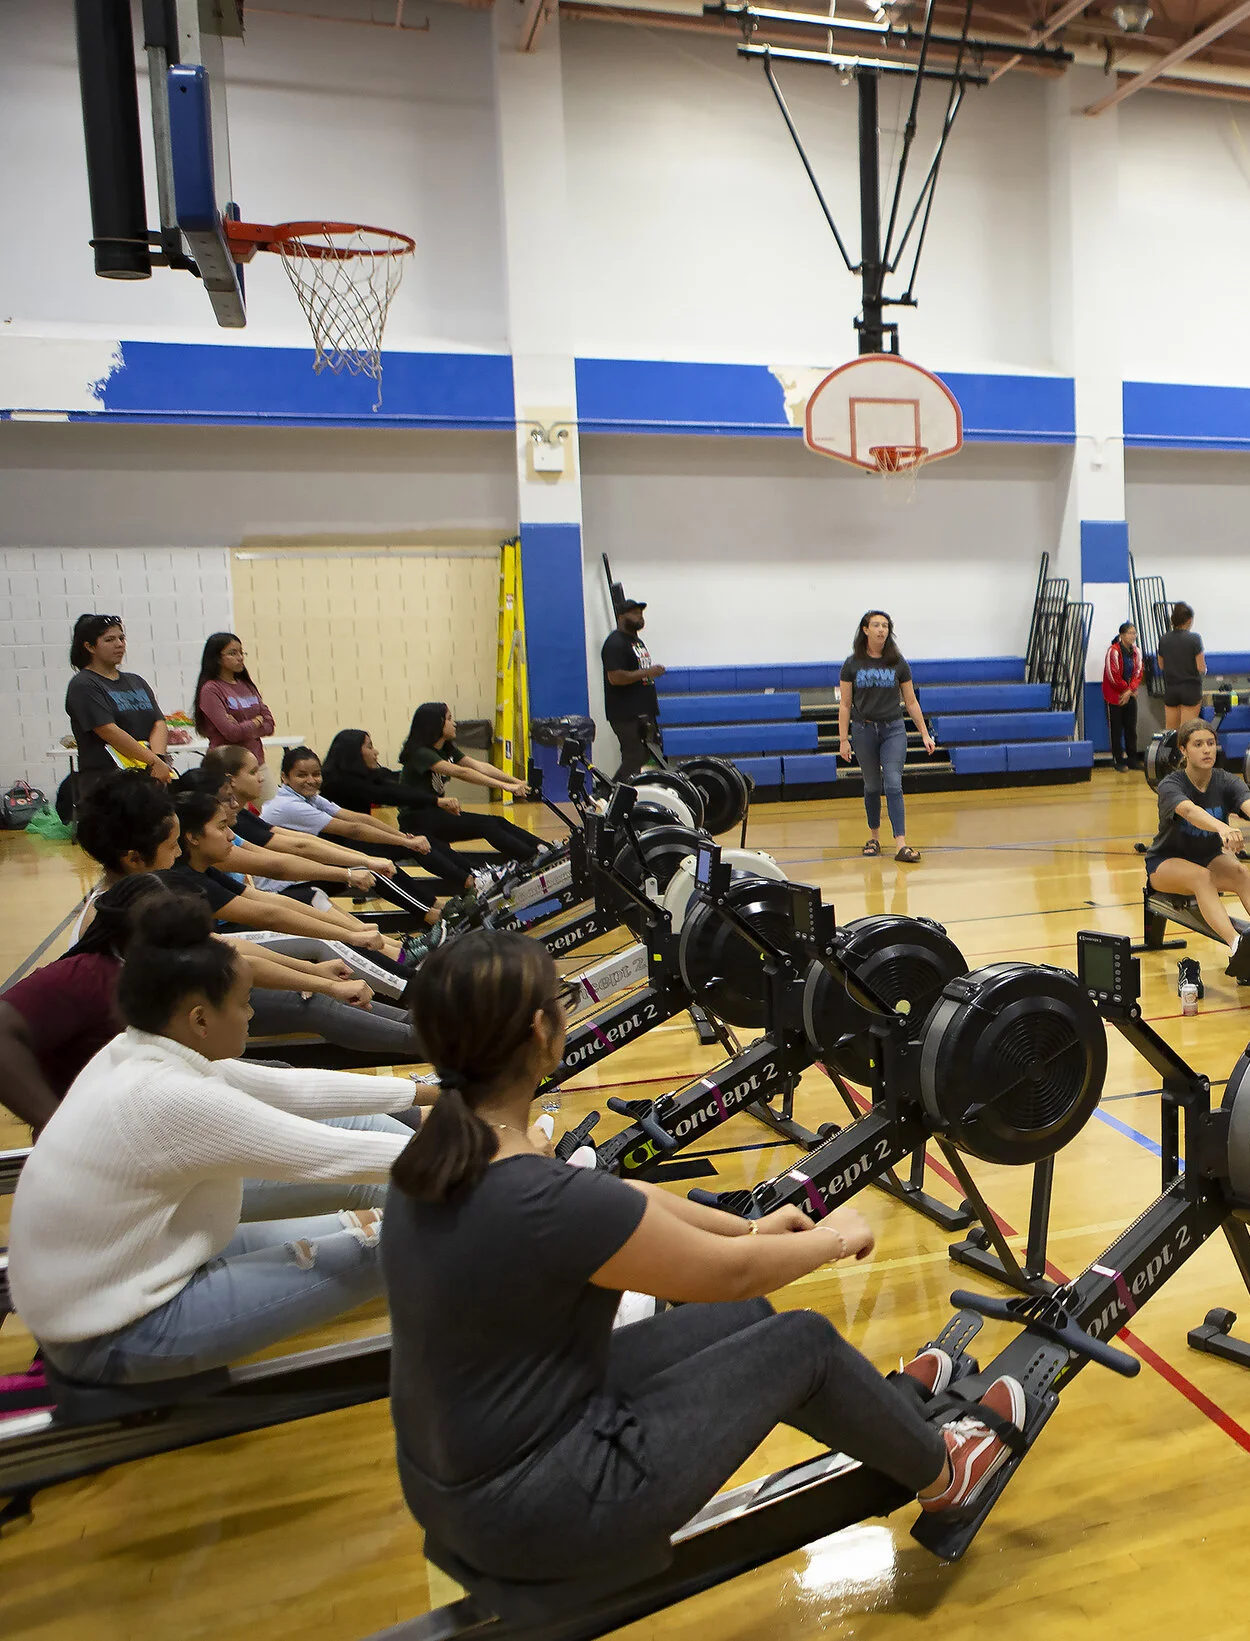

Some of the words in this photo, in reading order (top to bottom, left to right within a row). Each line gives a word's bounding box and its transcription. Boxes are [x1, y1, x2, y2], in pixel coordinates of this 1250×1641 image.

[856, 668, 896, 681] ROW
[546, 927, 585, 953] cept
[586, 921, 597, 933] 2
[566, 1013, 642, 1067] oncept
[644, 1003, 658, 1019] 2
[763, 1062, 779, 1081] 2
[874, 1139, 892, 1161] 2
[1175, 1225, 1192, 1250] 2
